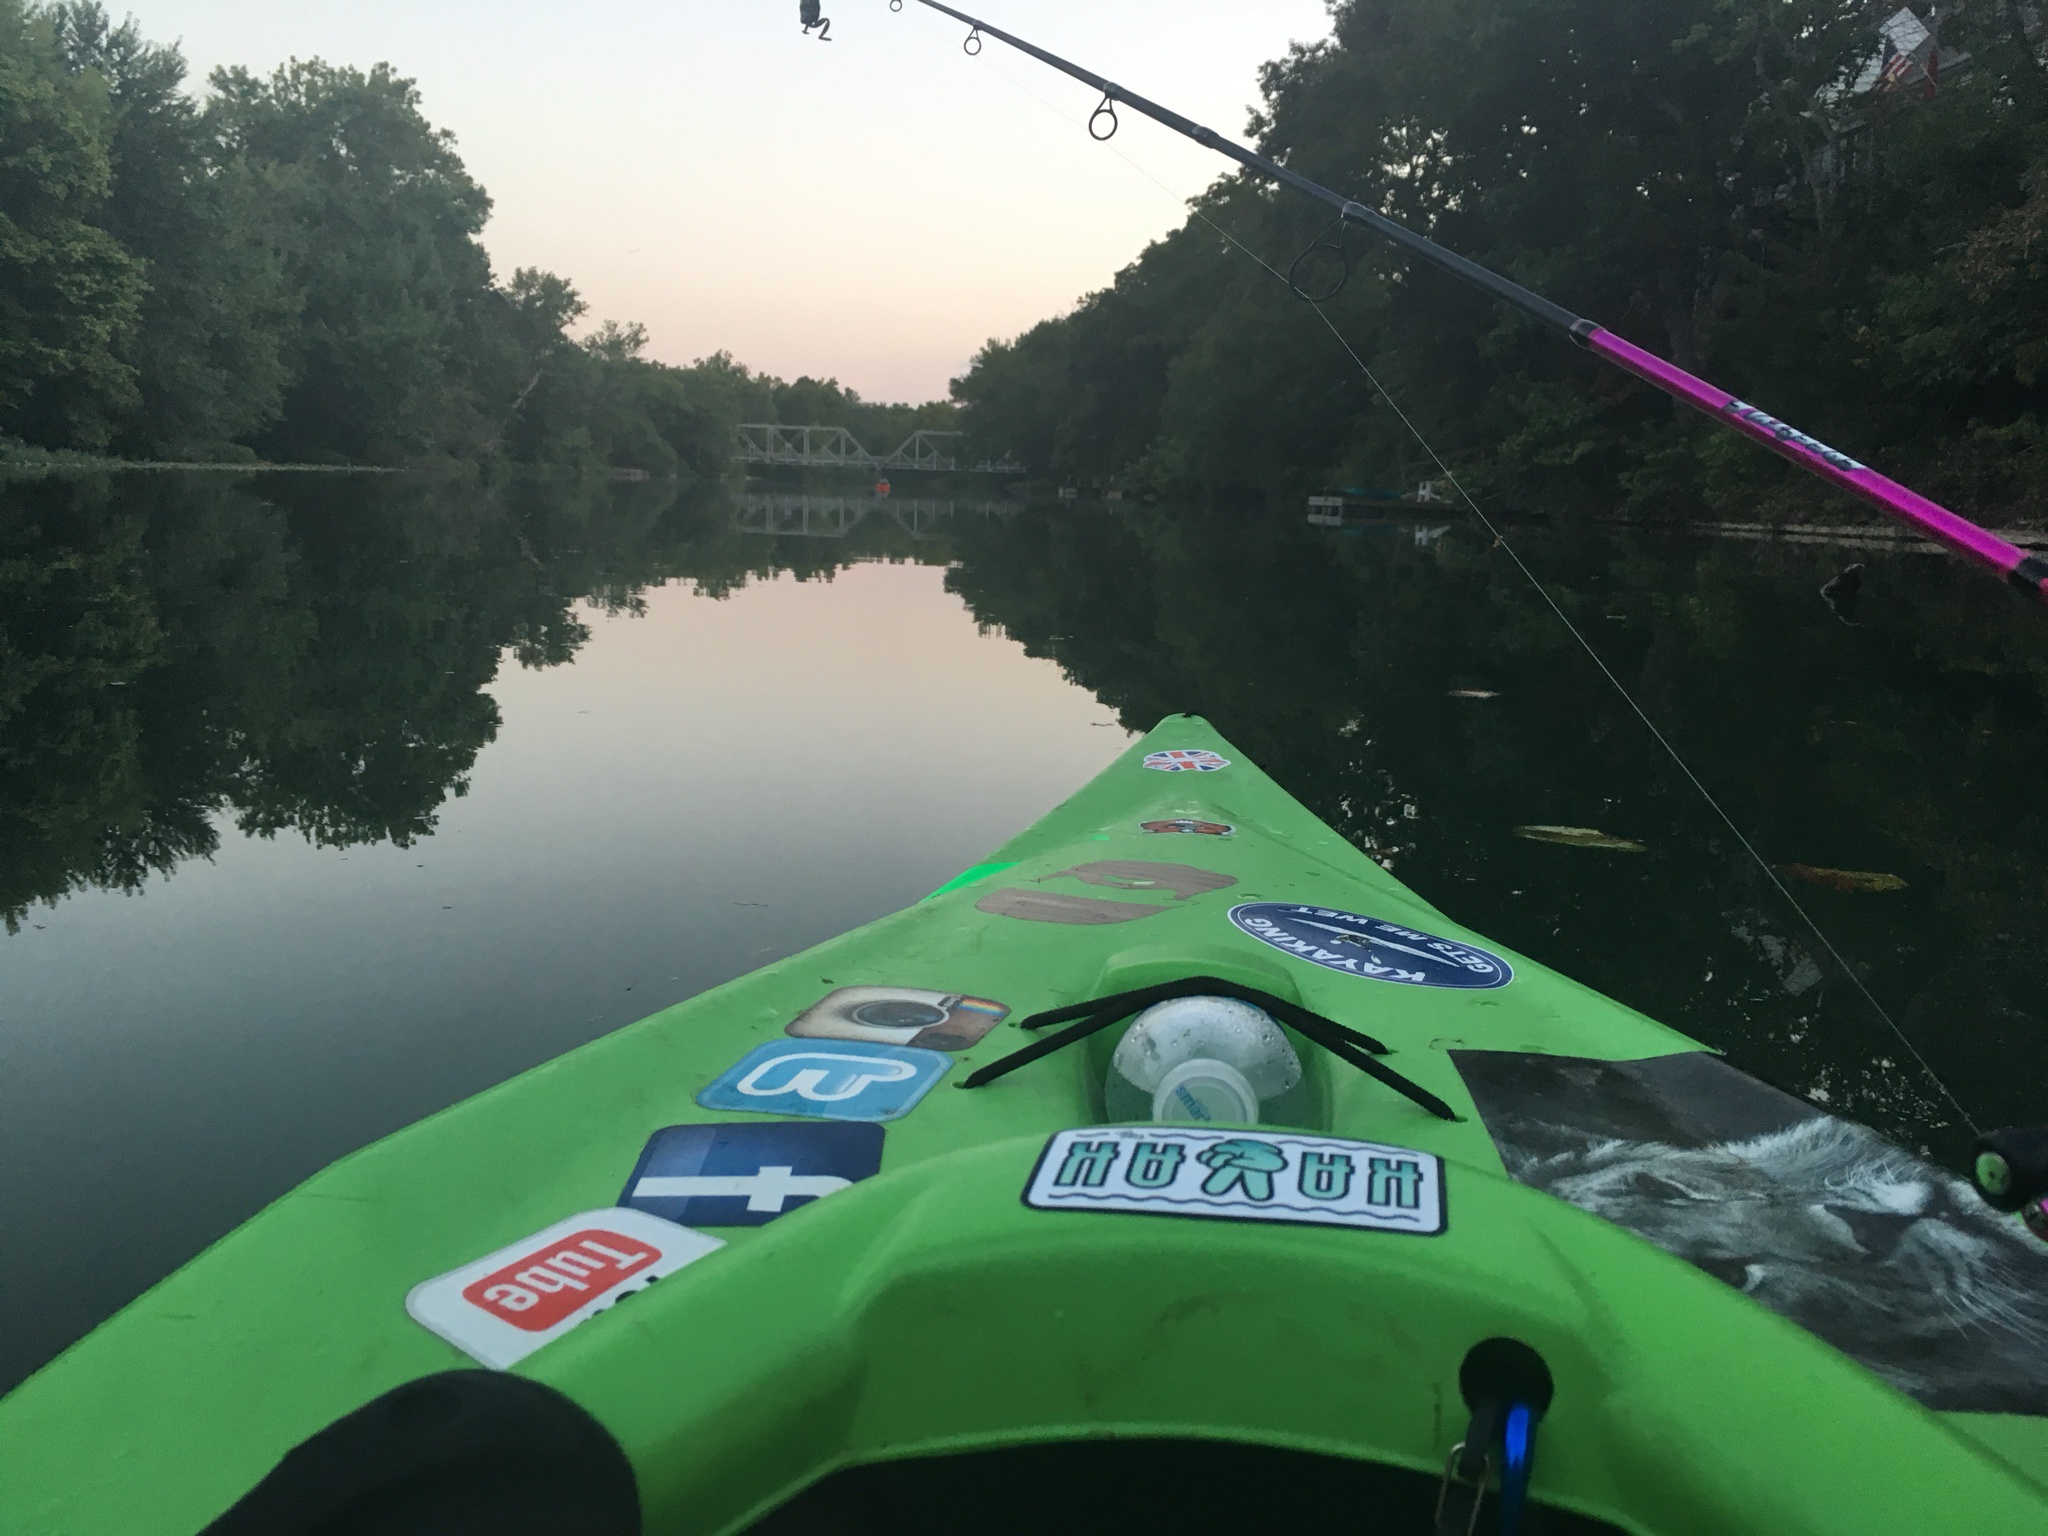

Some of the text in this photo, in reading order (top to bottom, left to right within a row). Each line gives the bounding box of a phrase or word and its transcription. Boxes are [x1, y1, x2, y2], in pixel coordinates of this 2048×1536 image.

[1244, 917, 1426, 983] KAYAKING
[1296, 906, 1495, 974] GETS ME WET
[482, 1239, 648, 1312] Tube
